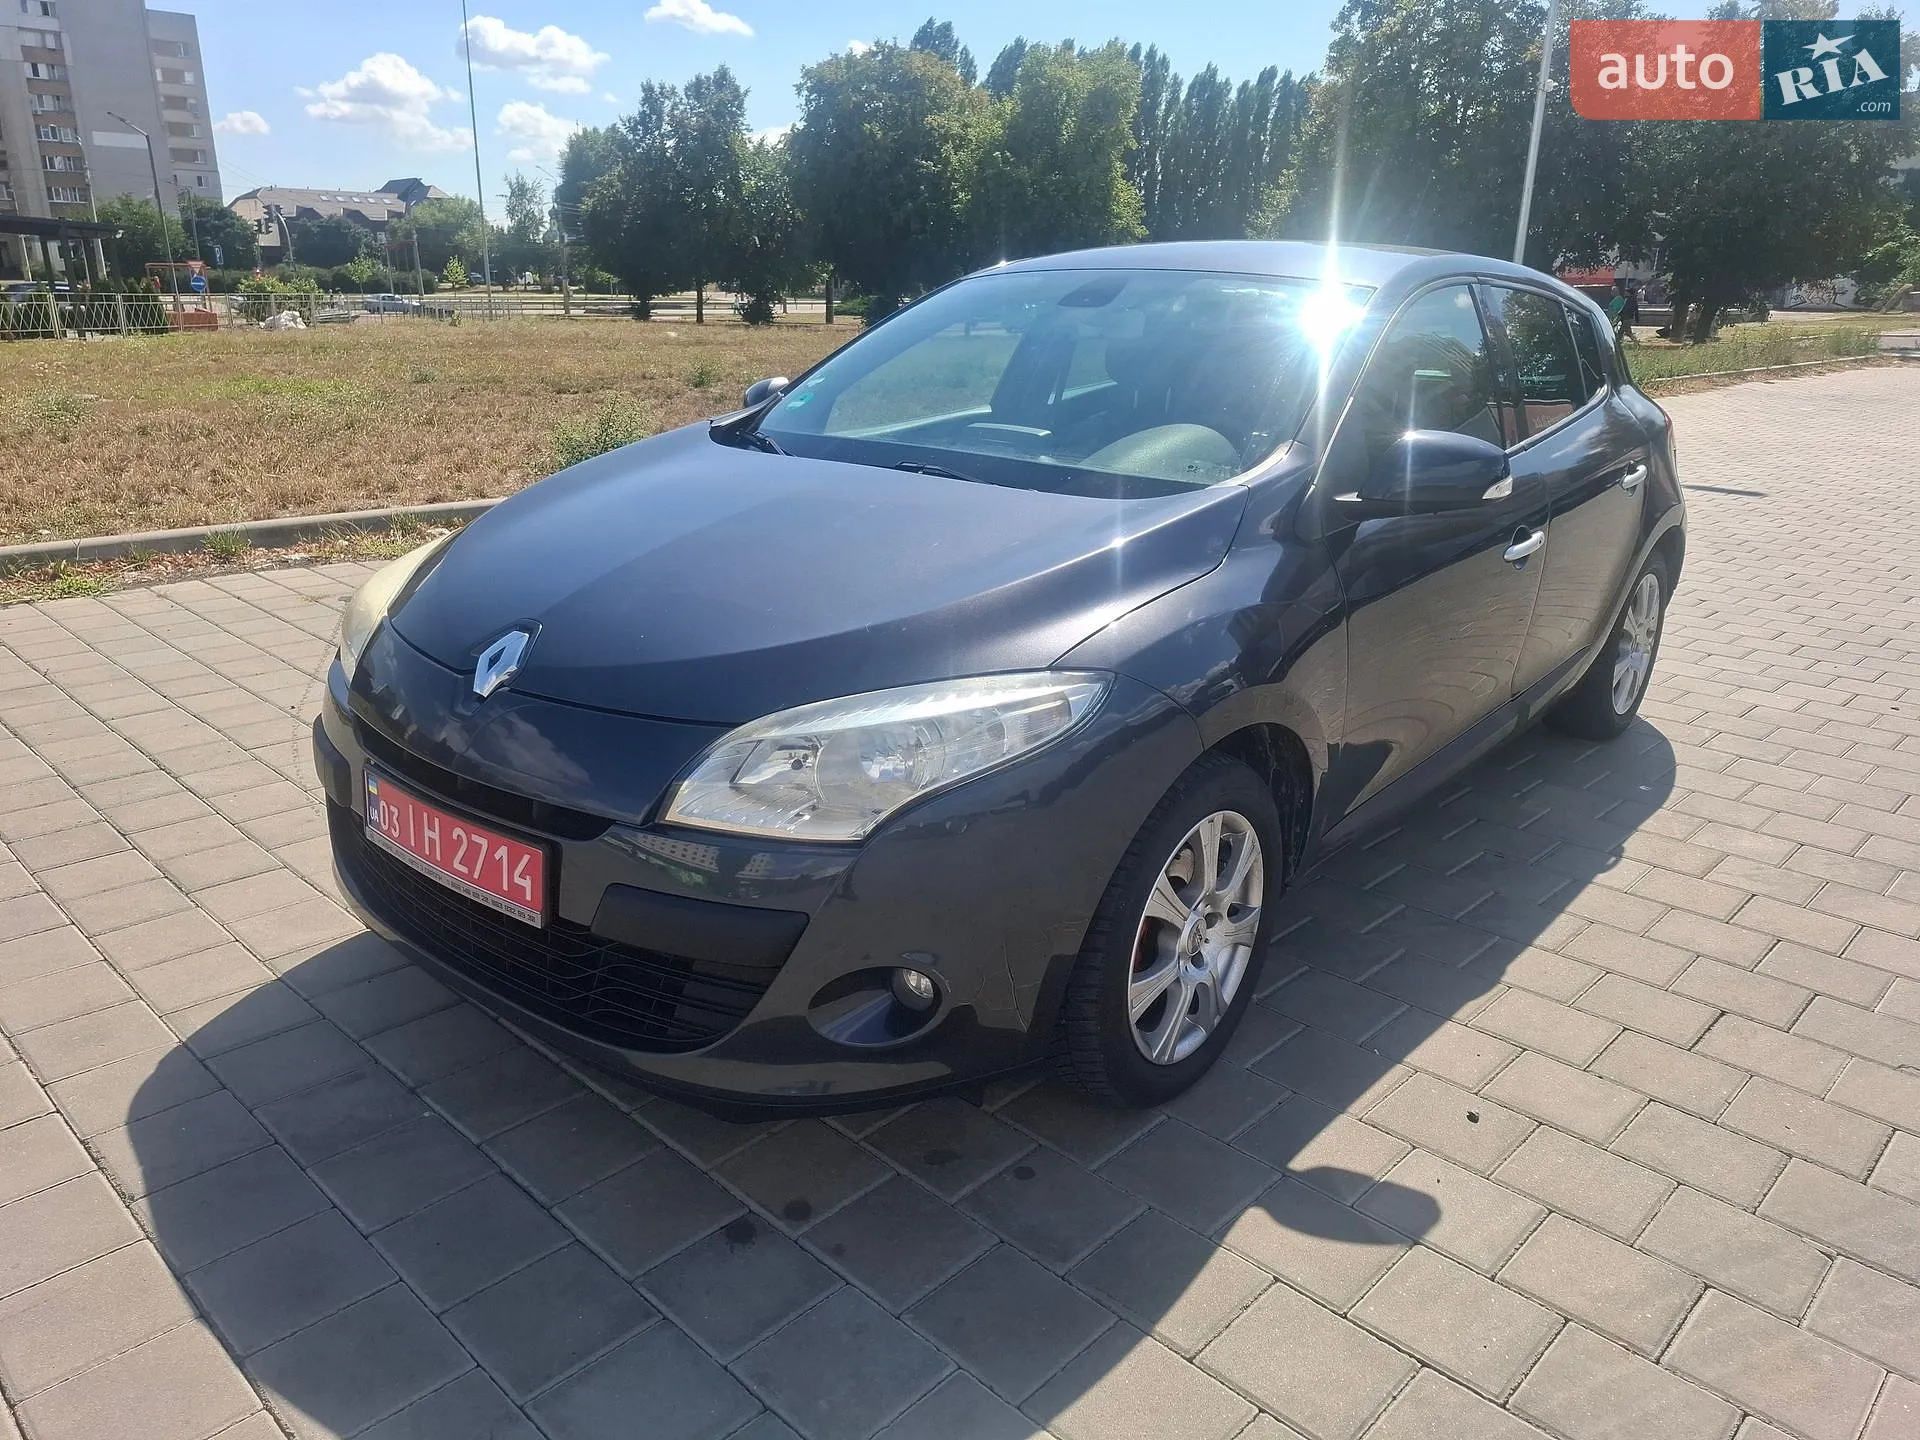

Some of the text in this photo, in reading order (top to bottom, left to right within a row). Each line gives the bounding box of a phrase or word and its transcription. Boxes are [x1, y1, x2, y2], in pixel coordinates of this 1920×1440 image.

[369, 806, 379, 823] UA
[380, 800, 400, 838] 03
[453, 828, 532, 901] 2714
